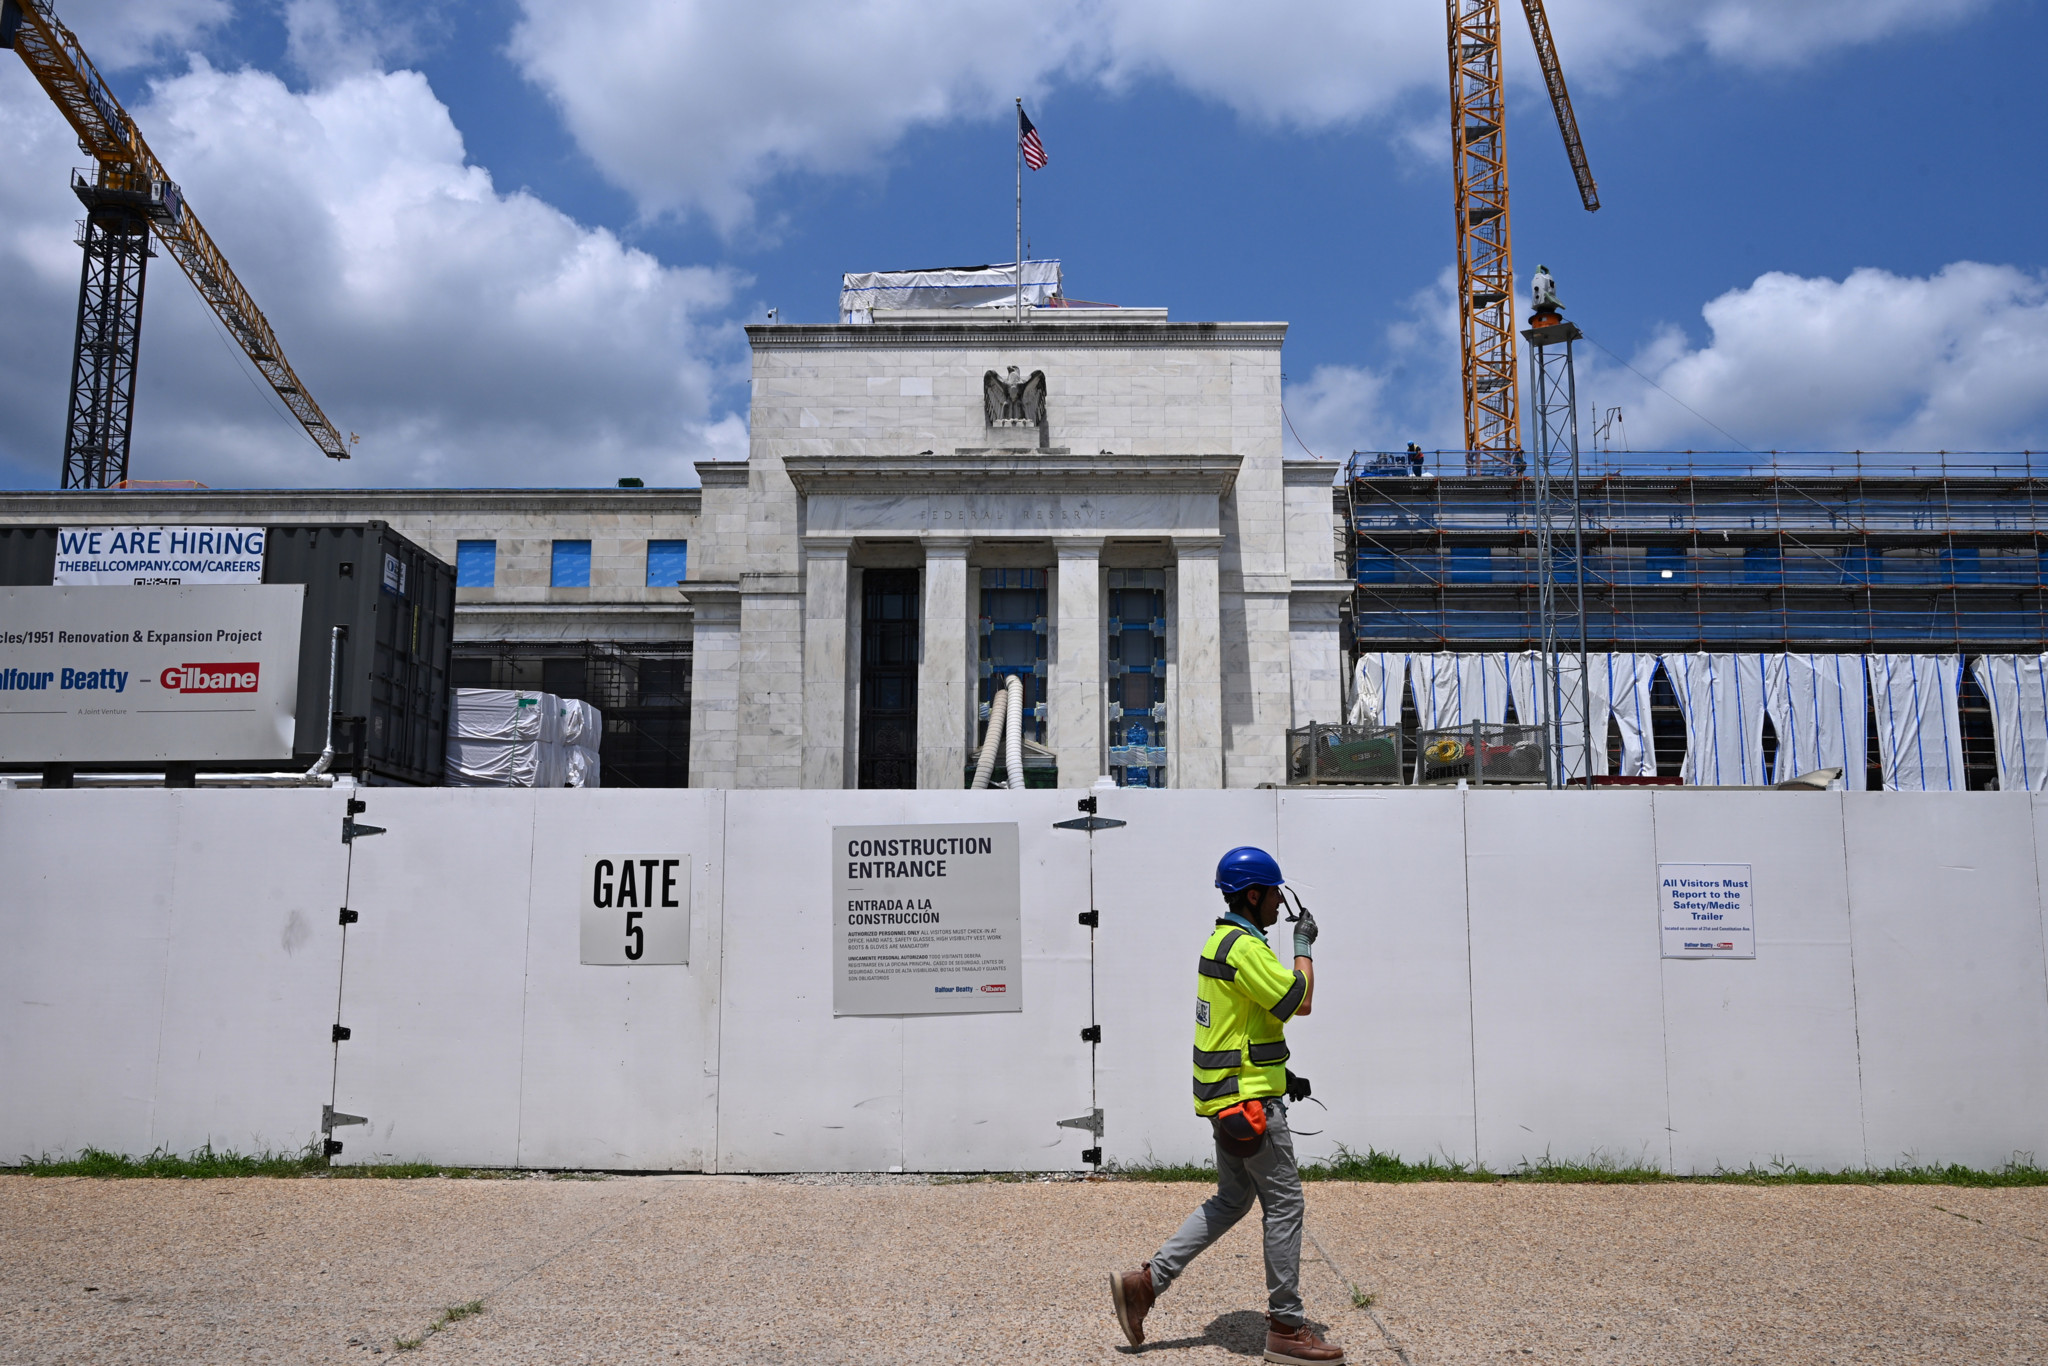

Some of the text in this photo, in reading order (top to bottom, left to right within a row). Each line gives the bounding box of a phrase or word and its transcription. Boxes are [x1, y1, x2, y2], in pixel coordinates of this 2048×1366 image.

[90, 83, 127, 146] SCHUSTER
[920, 510, 1106, 520] FEDERAL RESERVE
[60, 532, 264, 554] WE ARE HIRING
[58, 560, 260, 573] THEBELLCOMPANY.COM/CAREERS
[58, 630, 129, 644] Renovation
[133, 630, 143, 643] &
[147, 630, 212, 645] Expansion
[216, 629, 262, 644] Project
[60, 667, 128, 692] Beatty
[160, 667, 257, 690] Gilbane
[84, 708, 100, 716] Joint
[848, 837, 991, 857] CONSTRUCTION
[848, 860, 947, 879] ENTRANCE
[593, 859, 680, 908] GATE
[1662, 879, 1677, 887] All
[1680, 879, 1719, 887] Visitors
[1672, 890, 1706, 900] Report
[848, 899, 932, 911] ENTRADA A LA
[1673, 901, 1740, 910] Safety/Medic
[848, 910, 940, 925] CONSTRUCCIÓN
[1691, 912, 1723, 920] Trailer
[625, 911, 643, 960] 5
